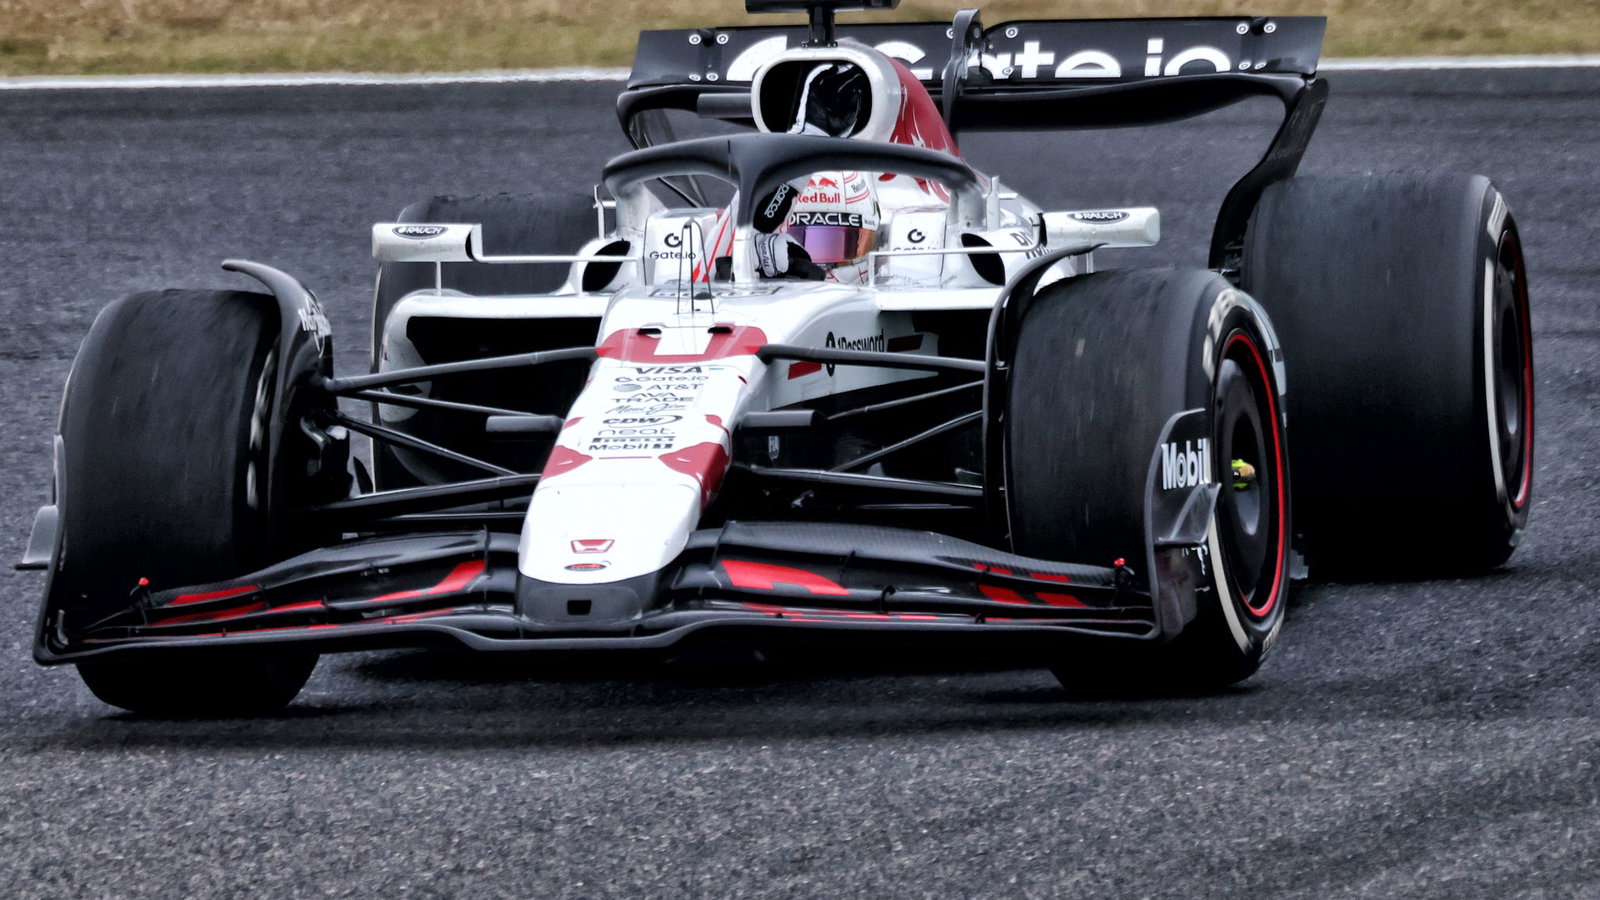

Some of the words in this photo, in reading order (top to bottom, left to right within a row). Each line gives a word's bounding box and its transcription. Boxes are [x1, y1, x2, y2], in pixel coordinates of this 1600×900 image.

[763, 183, 790, 219] parco
[796, 192, 817, 204] Red
[819, 192, 841, 204] Bull
[649, 251, 696, 260] Gate.io
[635, 366, 702, 374] VISA
[1161, 437, 1211, 490] Mobil
